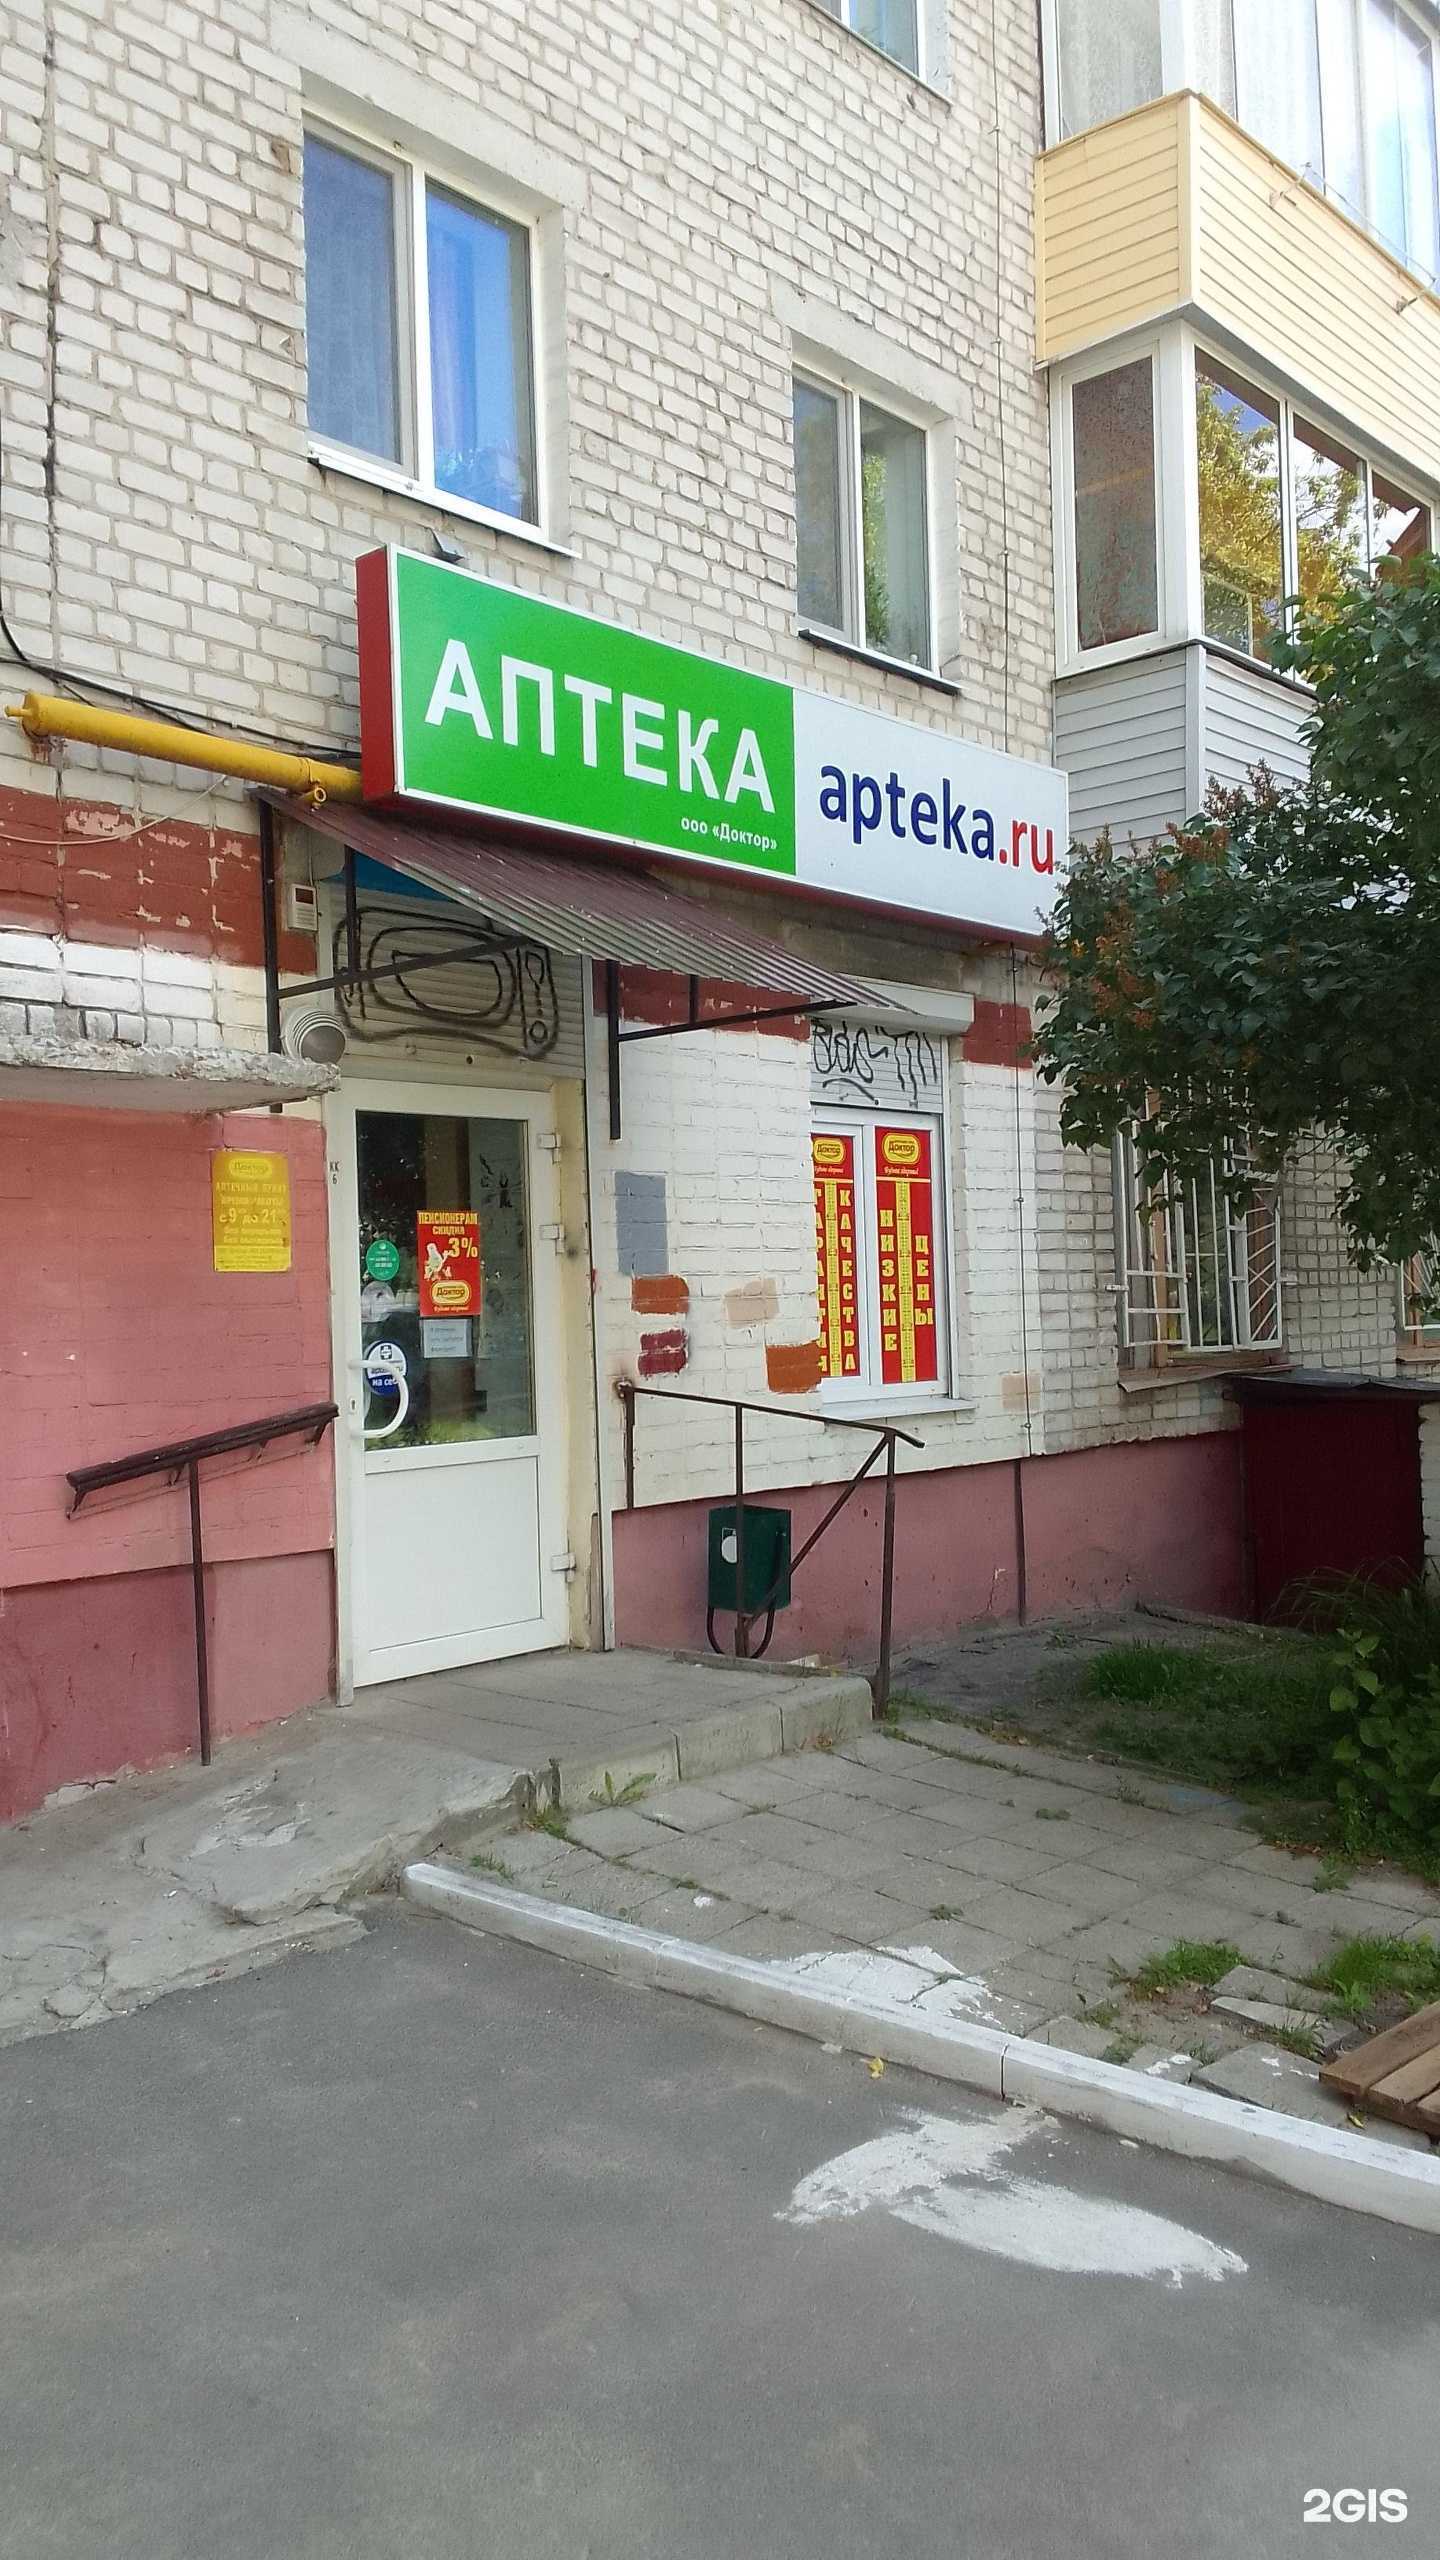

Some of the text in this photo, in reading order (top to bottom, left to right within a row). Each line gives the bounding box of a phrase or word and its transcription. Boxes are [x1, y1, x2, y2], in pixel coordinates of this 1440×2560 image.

[424, 638, 776, 814] АПТЕКА
[712, 823, 778, 852] «Доктор»
[819, 765, 1054, 875] apteka.ru
[418, 1212, 478, 1225] ПЕНСИОНЕРАМ
[432, 1225, 465, 1236] СКИДКА
[839, 1189, 857, 1370] КАЧЕСТВА
[880, 1209, 898, 1352] НИЗКИЕ
[915, 1234, 934, 1326] ЦЕНЫ
